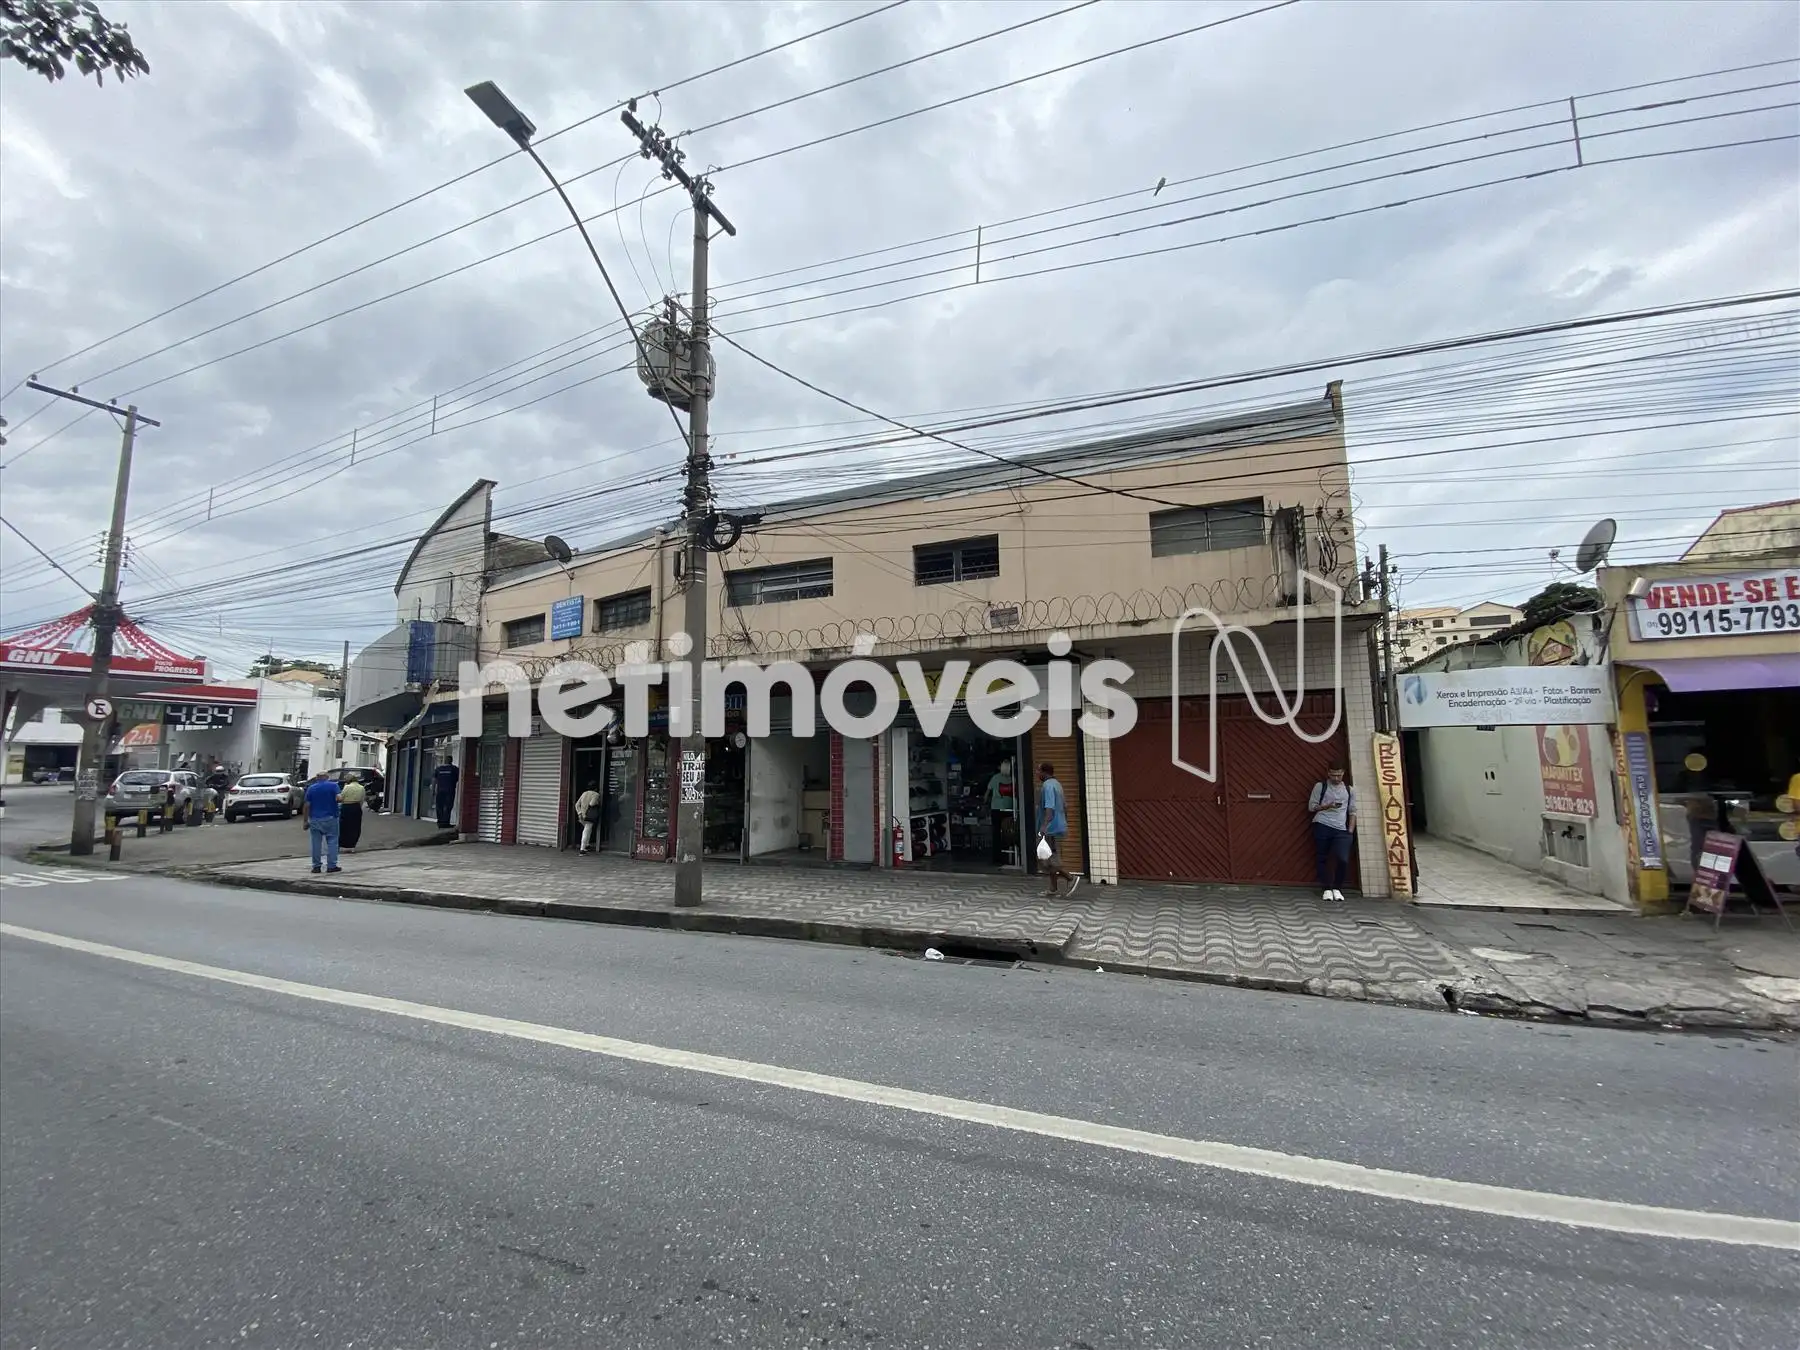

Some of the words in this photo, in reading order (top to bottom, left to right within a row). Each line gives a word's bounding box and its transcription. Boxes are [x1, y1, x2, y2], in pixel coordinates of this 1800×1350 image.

[1645, 577, 1780, 609] VENDE-SE
[1658, 603, 1799, 636] 99115-7793
[7, 649, 61, 665] GNV
[153, 665, 199, 675] PROGRESSO
[1436, 690, 1459, 700] Xerox
[1467, 687, 1509, 699] Impressão
[1542, 686, 1564, 695] Fotos
[1570, 685, 1602, 695] Banners
[1448, 698, 1507, 708] Encadernação
[1543, 696, 1592, 706] Plastificação
[119, 703, 161, 720] GNV
[683, 771, 695, 782] SEU
[1541, 765, 1584, 783] MARMITEX
[1378, 742, 1409, 893] RESTAURANTE
